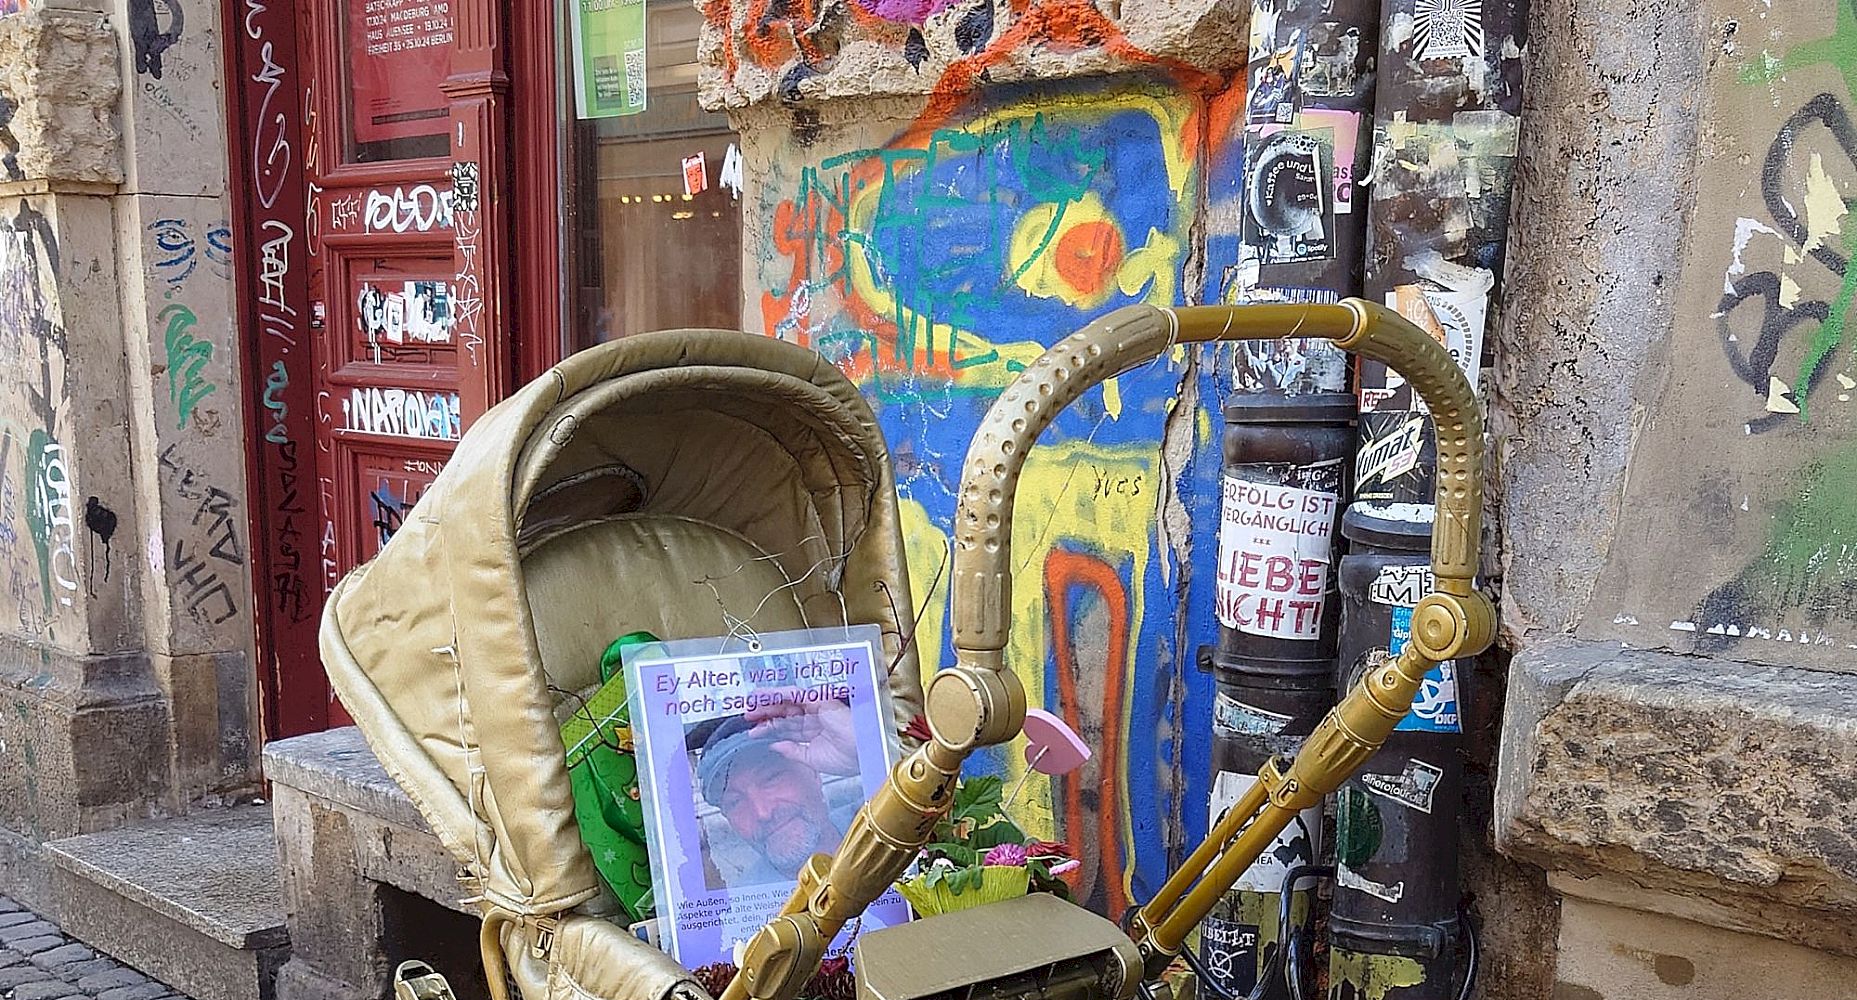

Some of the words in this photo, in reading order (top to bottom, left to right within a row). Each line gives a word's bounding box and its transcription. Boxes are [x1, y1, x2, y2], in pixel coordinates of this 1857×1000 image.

[1286, 159, 1308, 173] und
[1301, 494, 1334, 515] IST
[1217, 544, 1322, 596] LIEBE
[1216, 583, 1321, 635] NICHT!
[656, 673, 681, 694] Ey
[687, 668, 741, 690] Alter,
[749, 665, 788, 683] was
[795, 660, 824, 679] ich
[830, 657, 860, 676] Dir
[664, 694, 716, 716] noch
[722, 690, 784, 712] sagen
[790, 683, 857, 704] wollte:
[696, 897, 728, 908] Außen,
[890, 896, 902, 904] zu
[677, 909, 713, 921] Aspekte
[715, 907, 732, 916] und
[735, 905, 753, 914] alte
